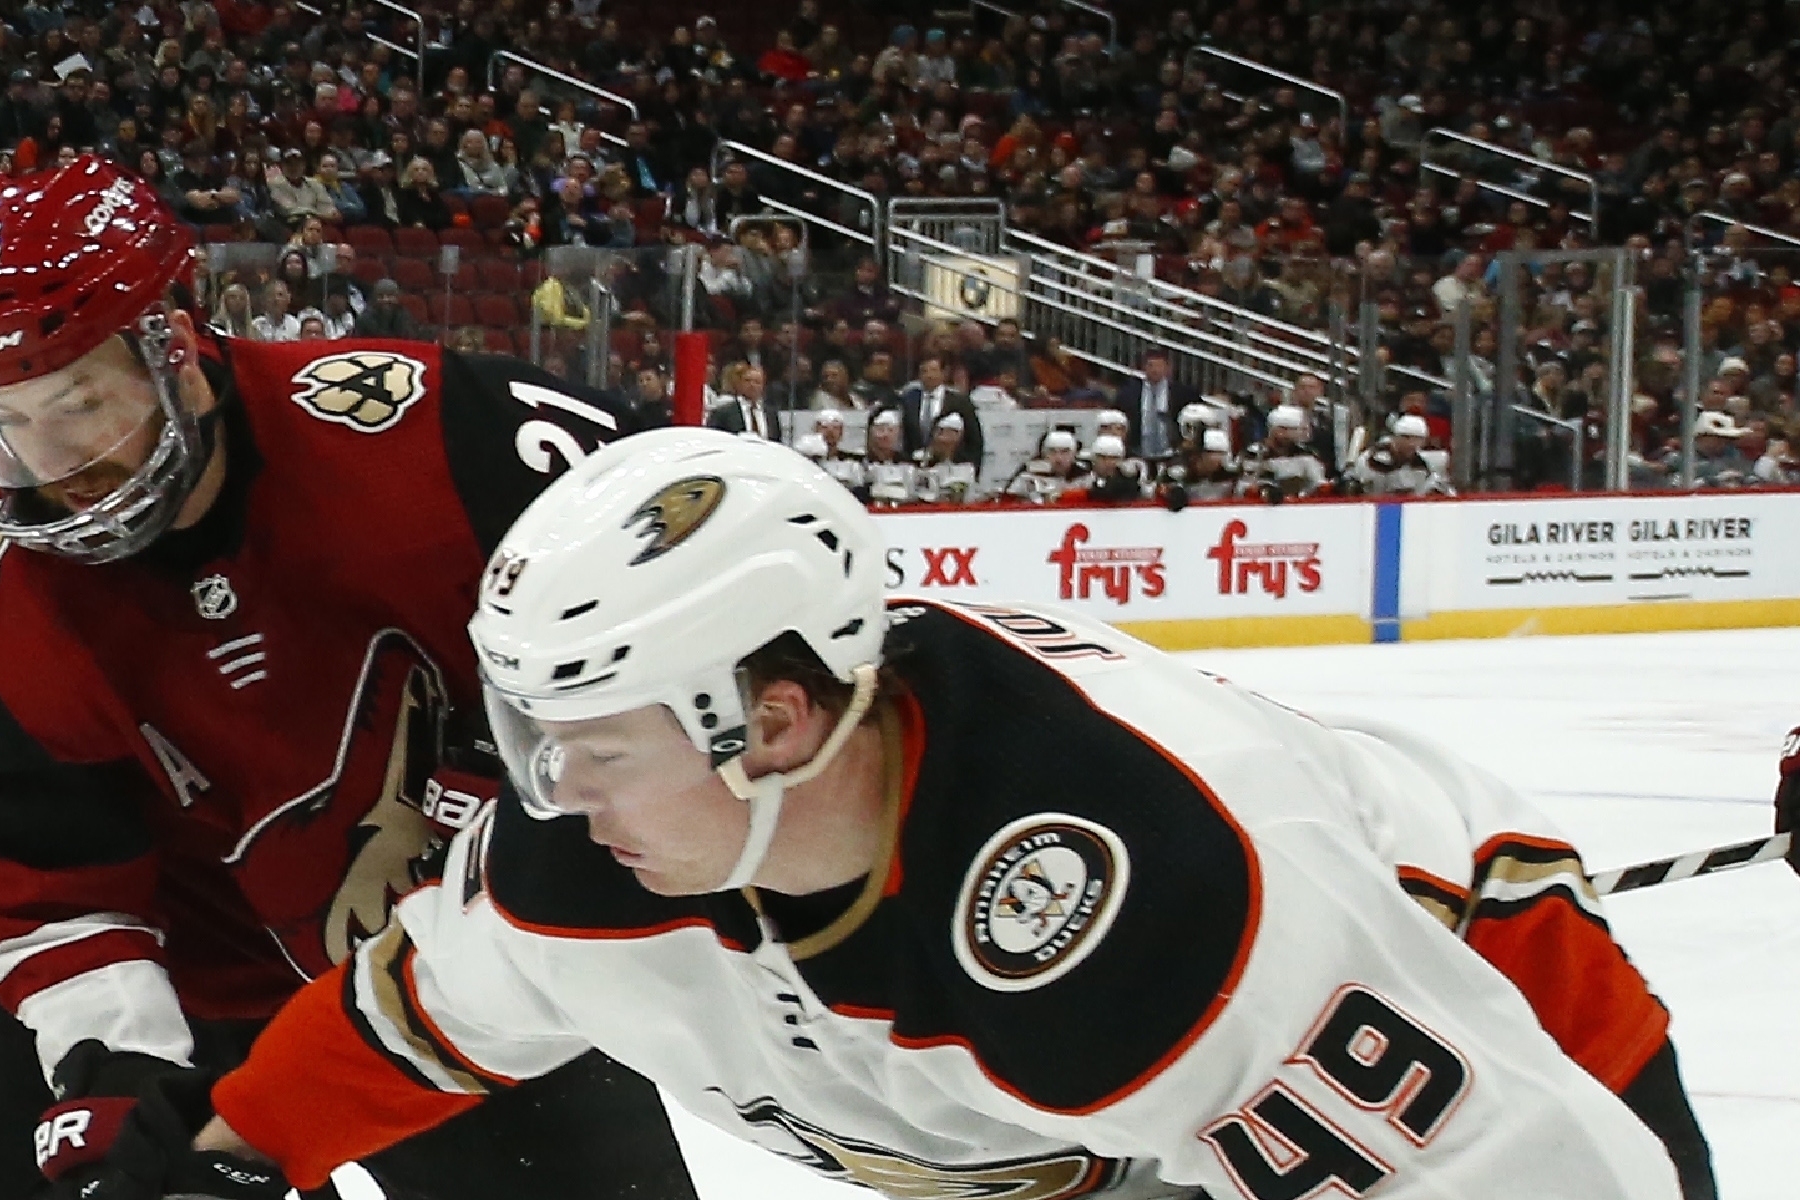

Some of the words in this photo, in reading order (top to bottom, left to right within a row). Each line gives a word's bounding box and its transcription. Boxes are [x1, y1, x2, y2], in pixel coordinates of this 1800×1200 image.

[1487, 523, 1540, 544] GILA
[1546, 521, 1614, 543] RIVER
[1628, 520, 1678, 541] GILA
[1685, 518, 1752, 539] RIVER
[919, 547, 979, 587] XX
[138, 722, 212, 808] A
